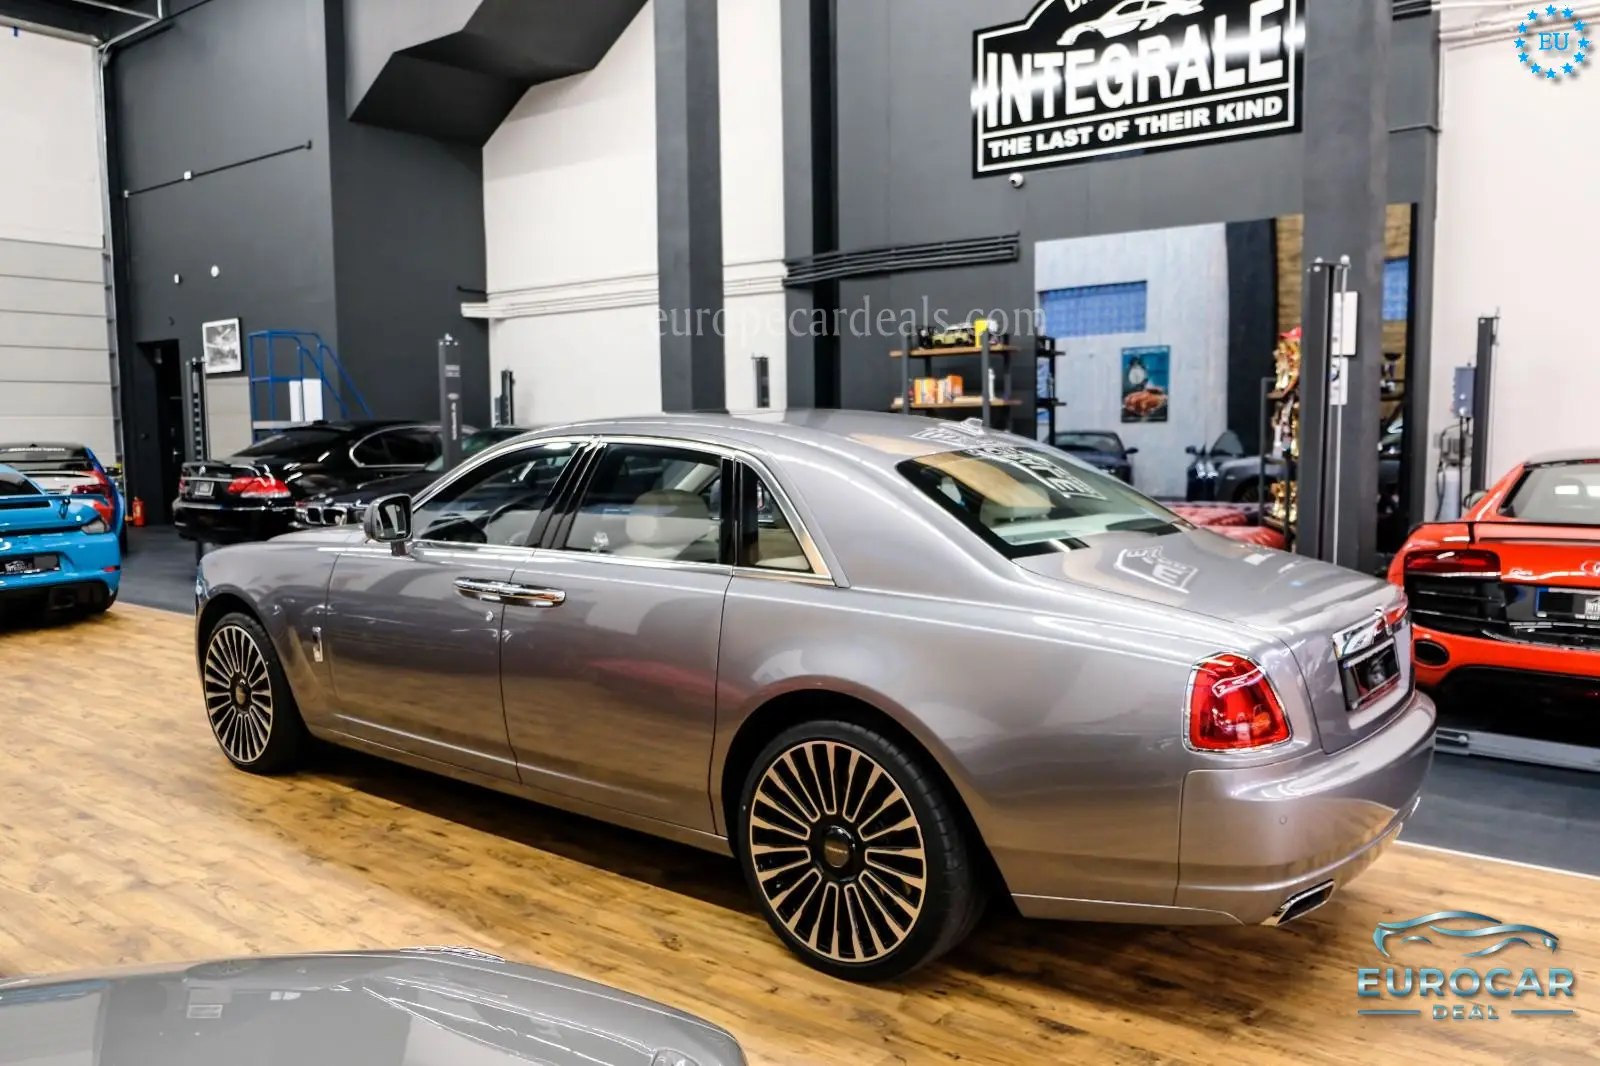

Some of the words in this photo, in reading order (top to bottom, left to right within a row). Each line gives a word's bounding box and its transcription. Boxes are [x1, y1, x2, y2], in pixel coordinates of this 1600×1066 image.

[986, 0, 1284, 128] INTEGRALE
[988, 135, 1032, 158] THE
[1036, 126, 1094, 152] LAST
[1098, 120, 1130, 142] OF
[1135, 105, 1210, 135] THEIR
[1216, 96, 1283, 124] KIND
